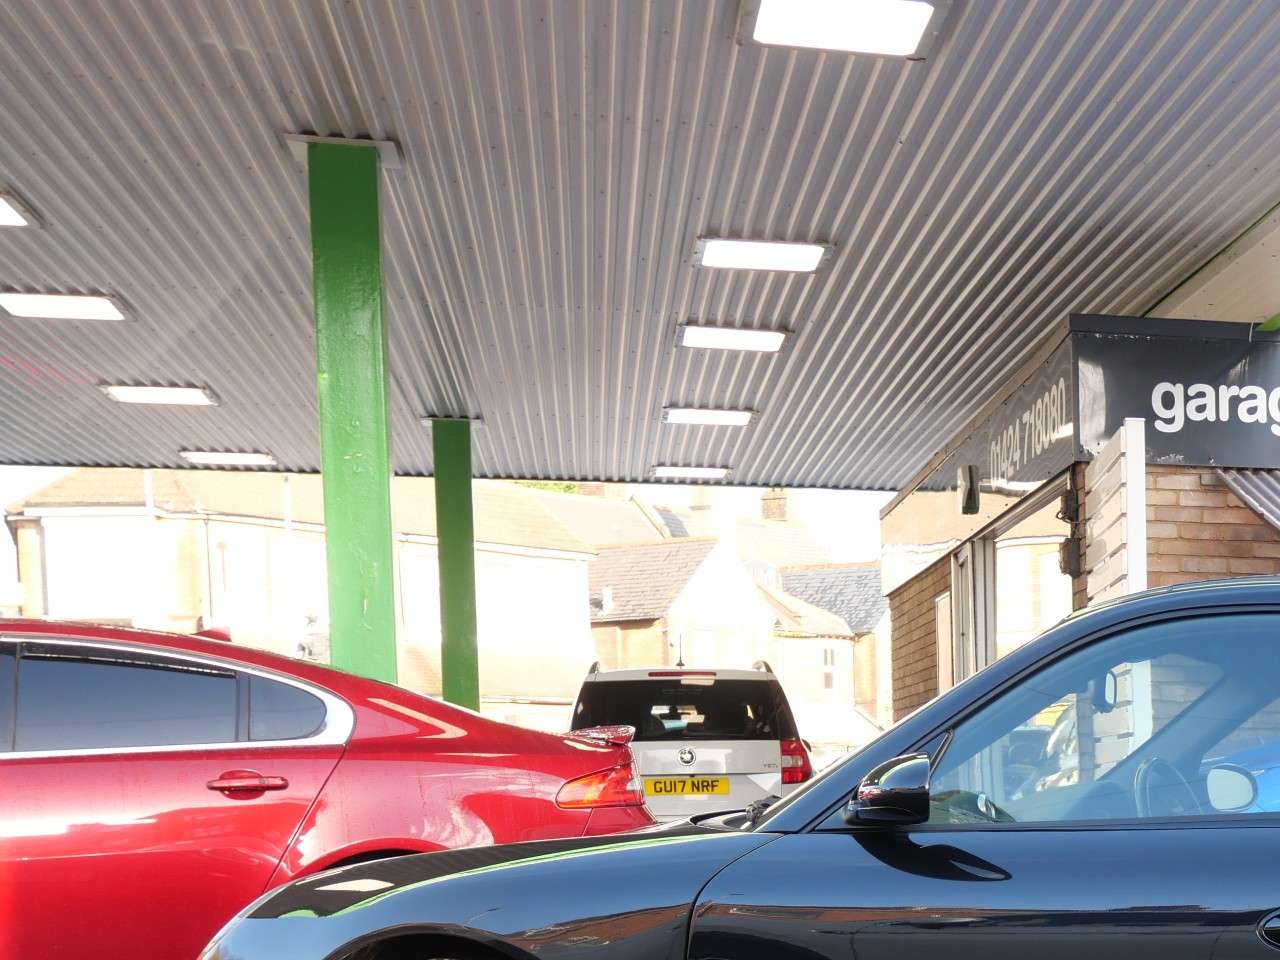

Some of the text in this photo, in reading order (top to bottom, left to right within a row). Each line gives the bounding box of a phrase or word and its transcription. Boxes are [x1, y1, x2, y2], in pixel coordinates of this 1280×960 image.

[991, 377, 1066, 491] 01424 718080
[653, 780, 720, 793] GU17 NRF
